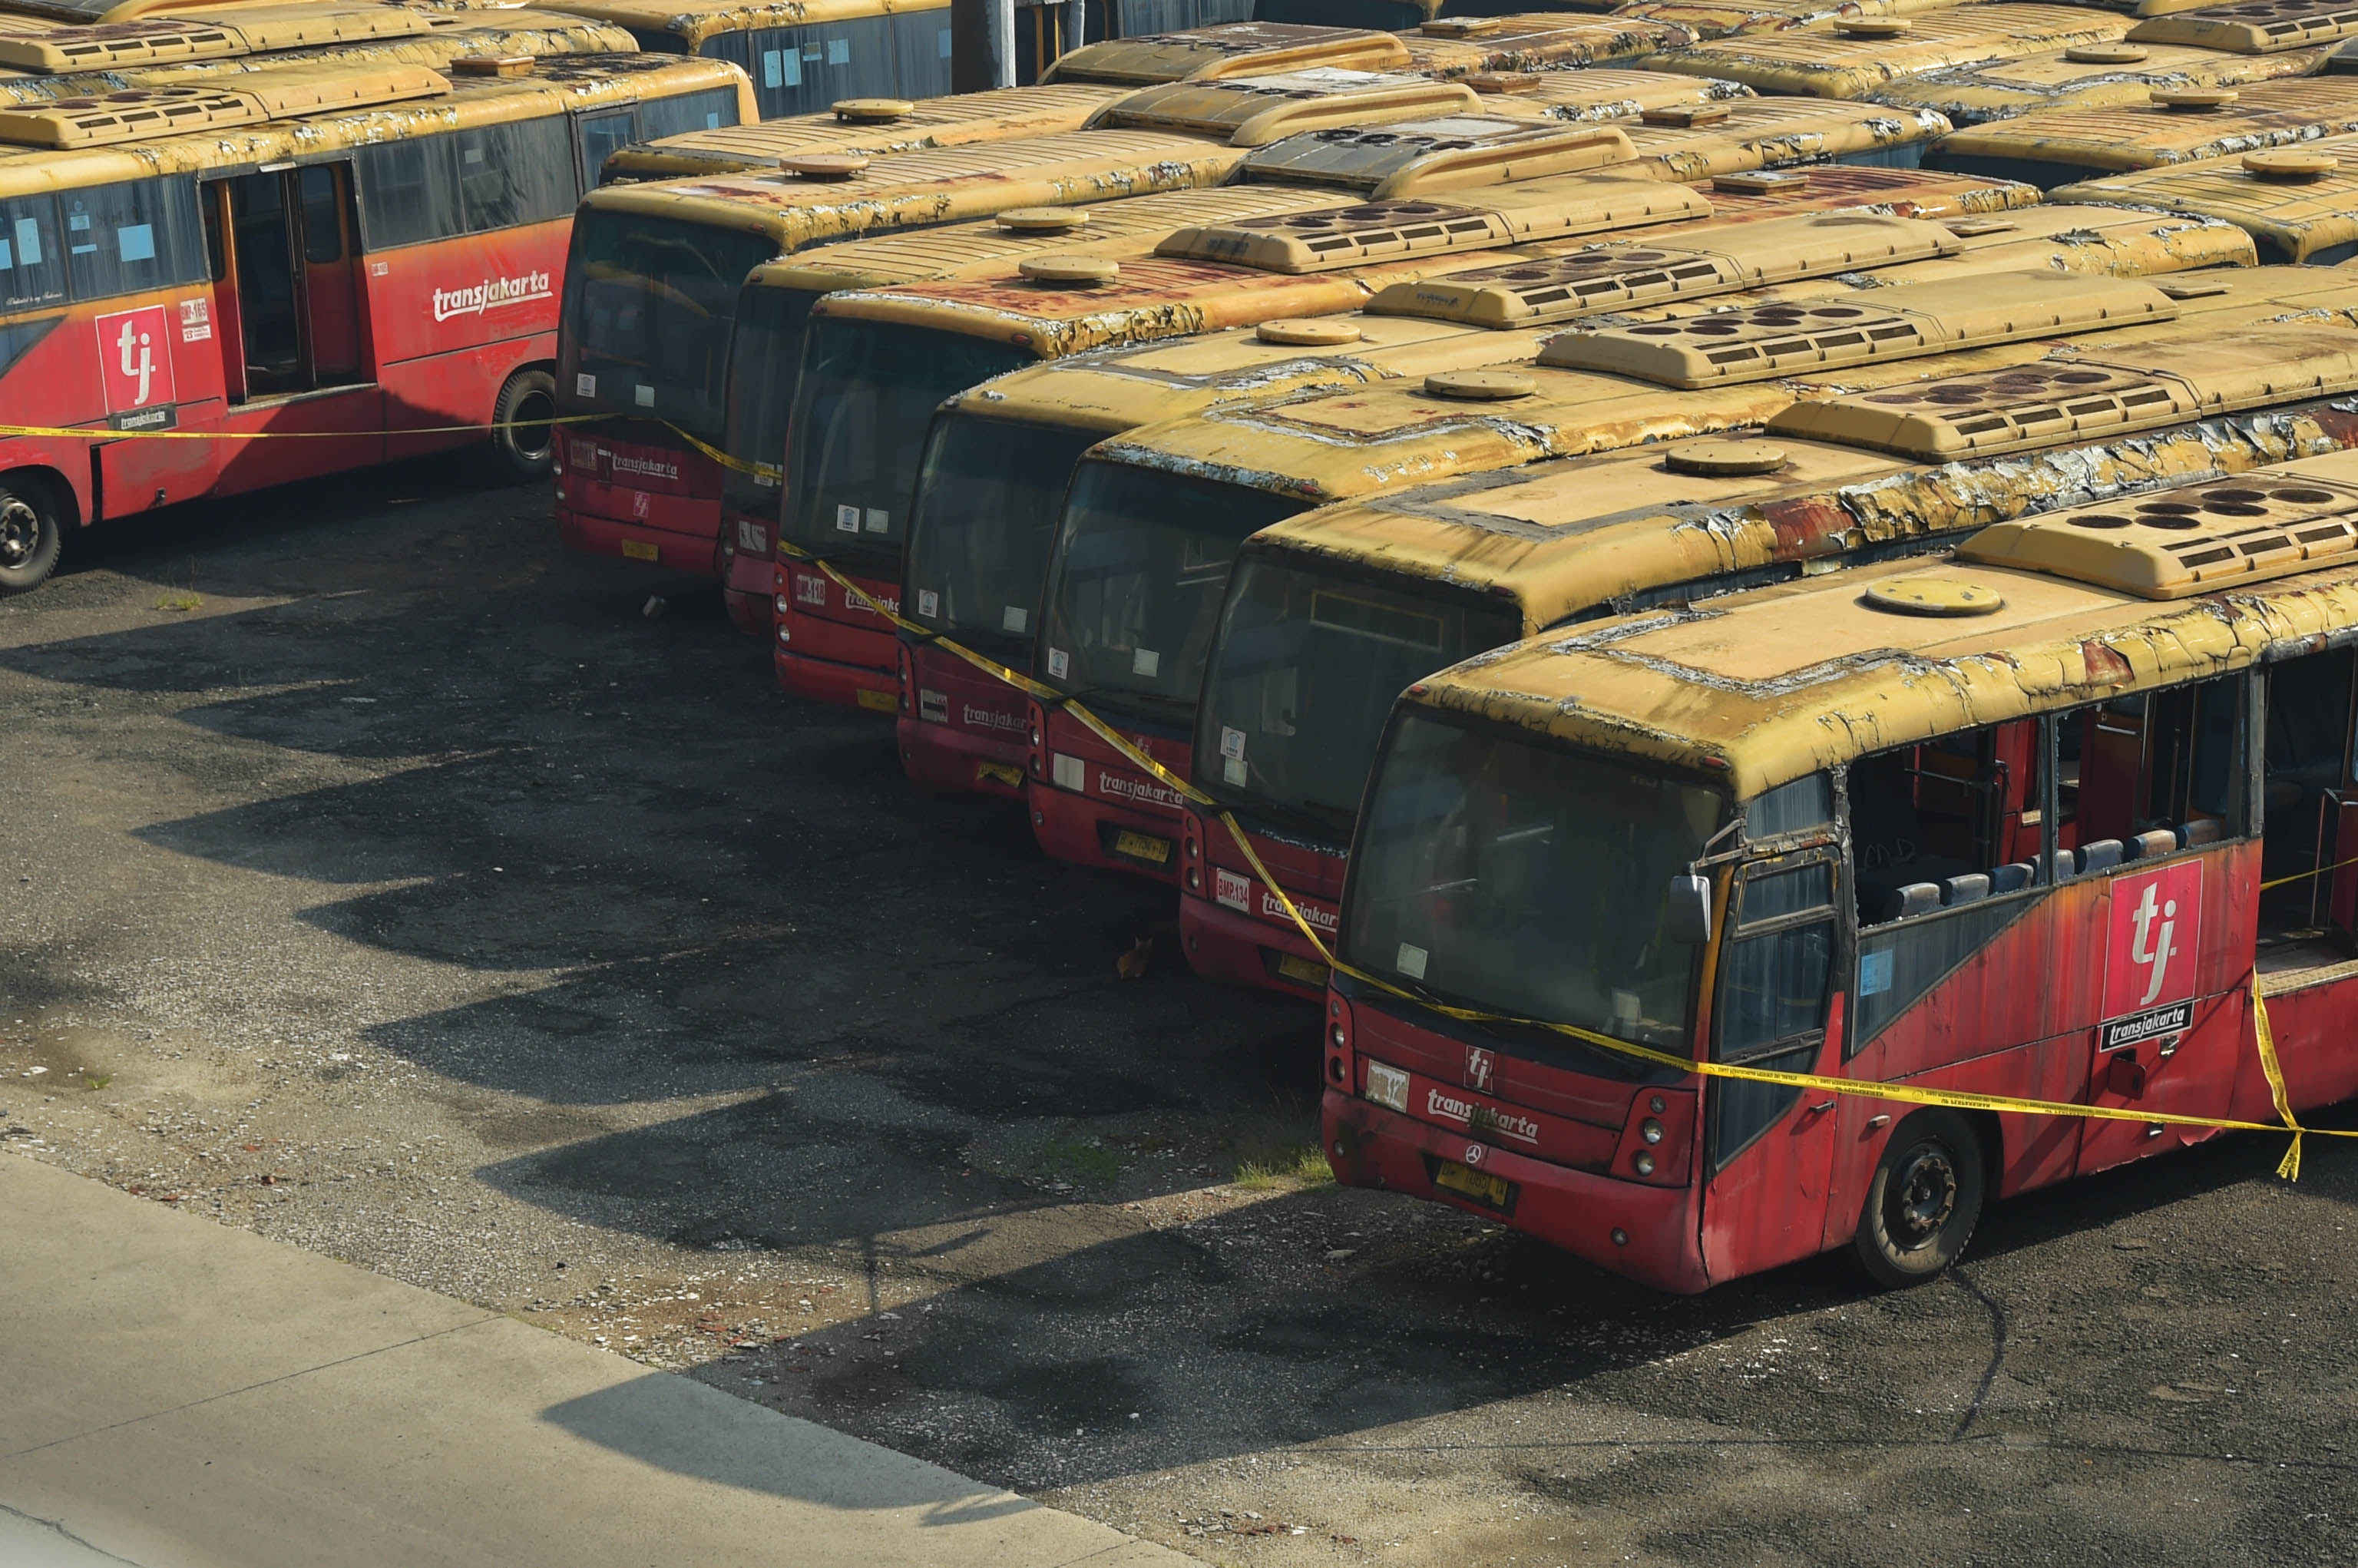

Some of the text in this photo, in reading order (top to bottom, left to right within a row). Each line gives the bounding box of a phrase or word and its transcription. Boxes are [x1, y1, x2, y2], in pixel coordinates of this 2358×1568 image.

[433, 270, 553, 322] transjakarta
[121, 411, 166, 430] transjakarta
[612, 453, 679, 480] transjakarta
[1100, 772, 1184, 810] transjakarta
[2109, 1007, 2186, 1045] transjakarta
[1427, 1089, 1539, 1144] transjakarta
